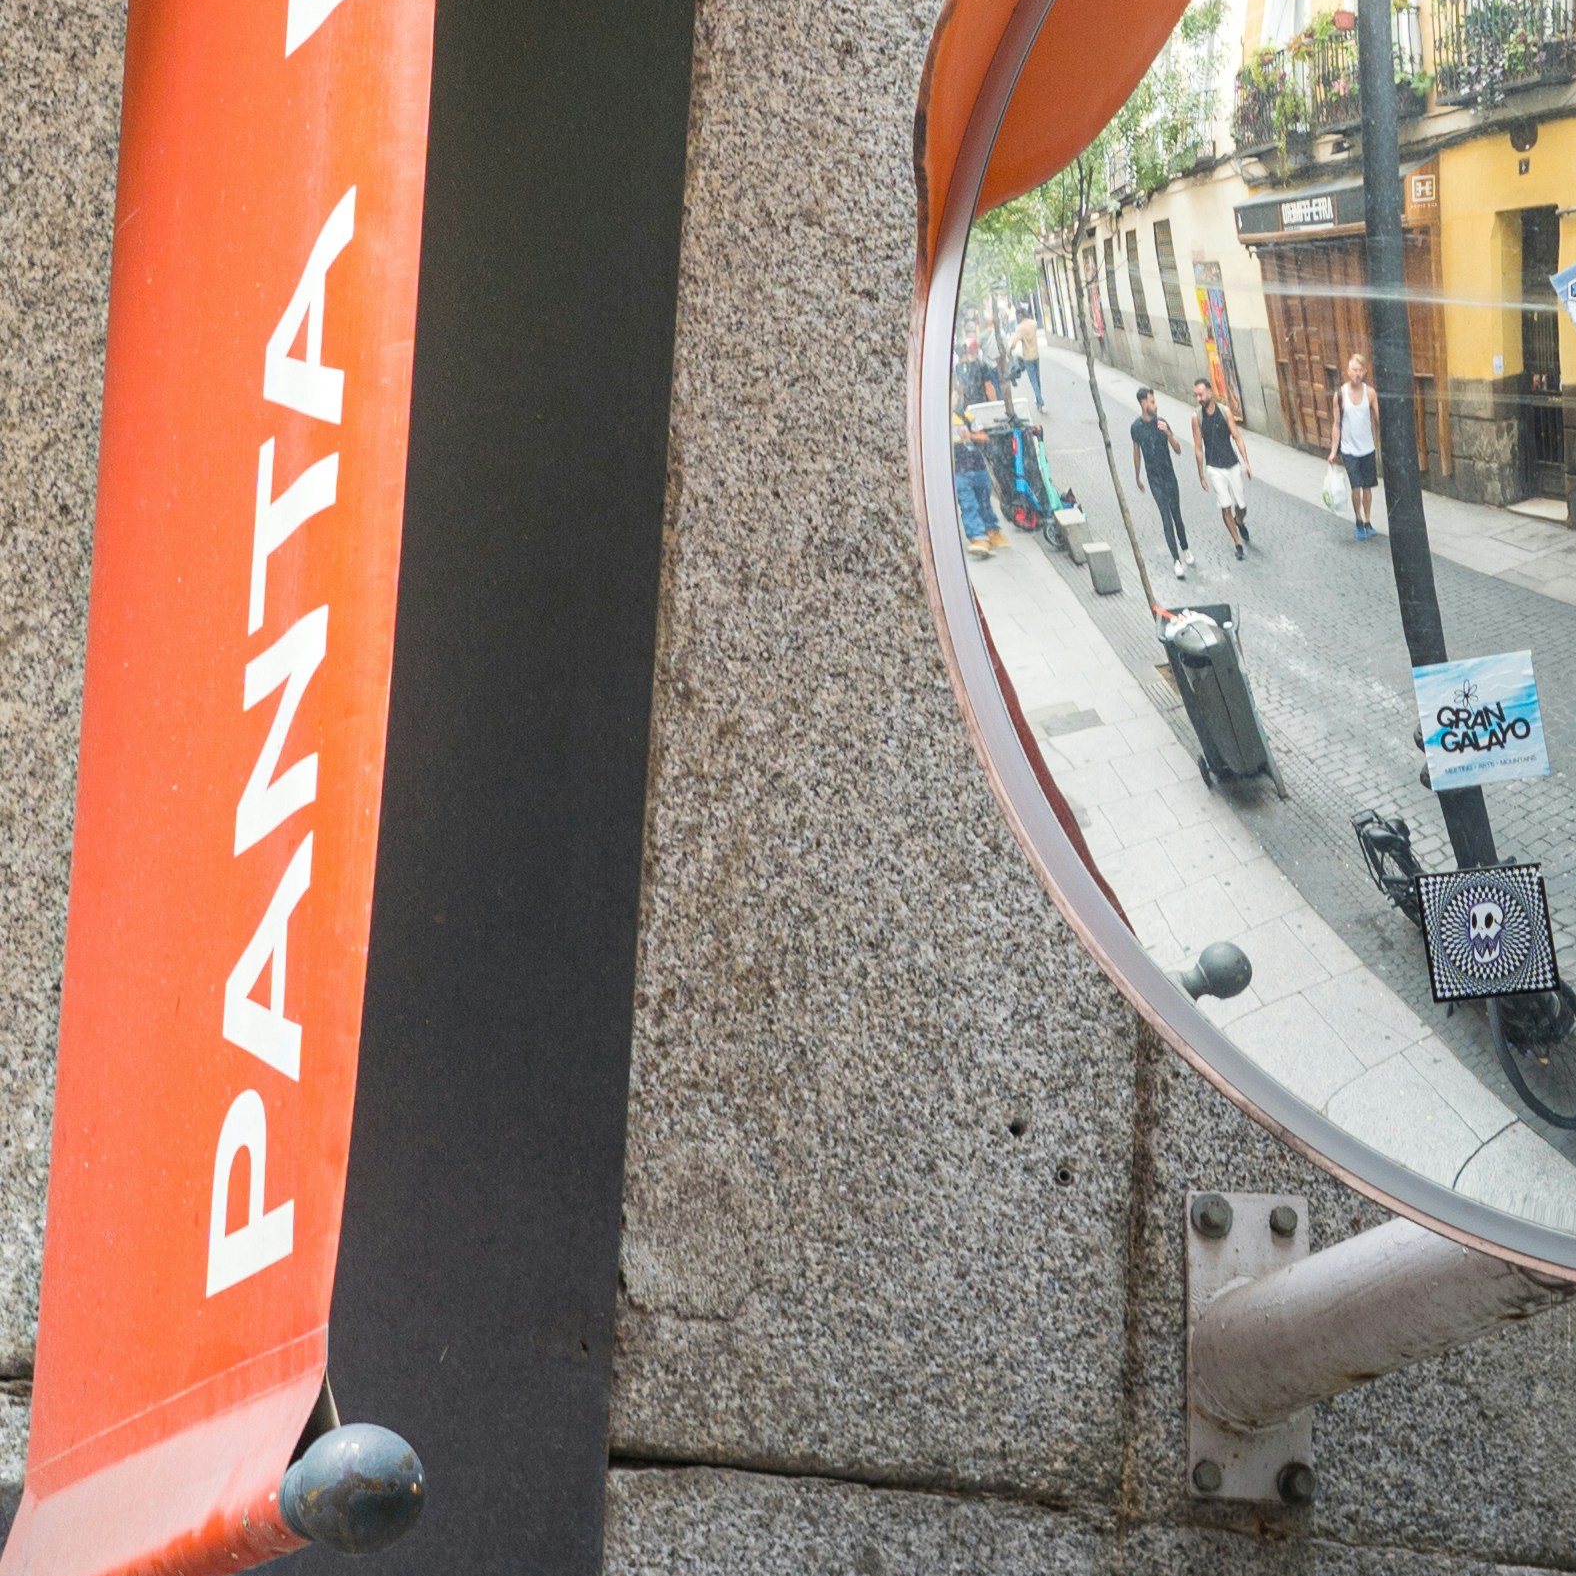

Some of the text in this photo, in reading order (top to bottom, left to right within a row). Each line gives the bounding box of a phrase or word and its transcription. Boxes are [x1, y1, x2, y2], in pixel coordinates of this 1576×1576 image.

[1437, 701, 1507, 731] GRAN
[205, 185, 357, 1298] PANTA
[1440, 717, 1531, 753] GALAYO
